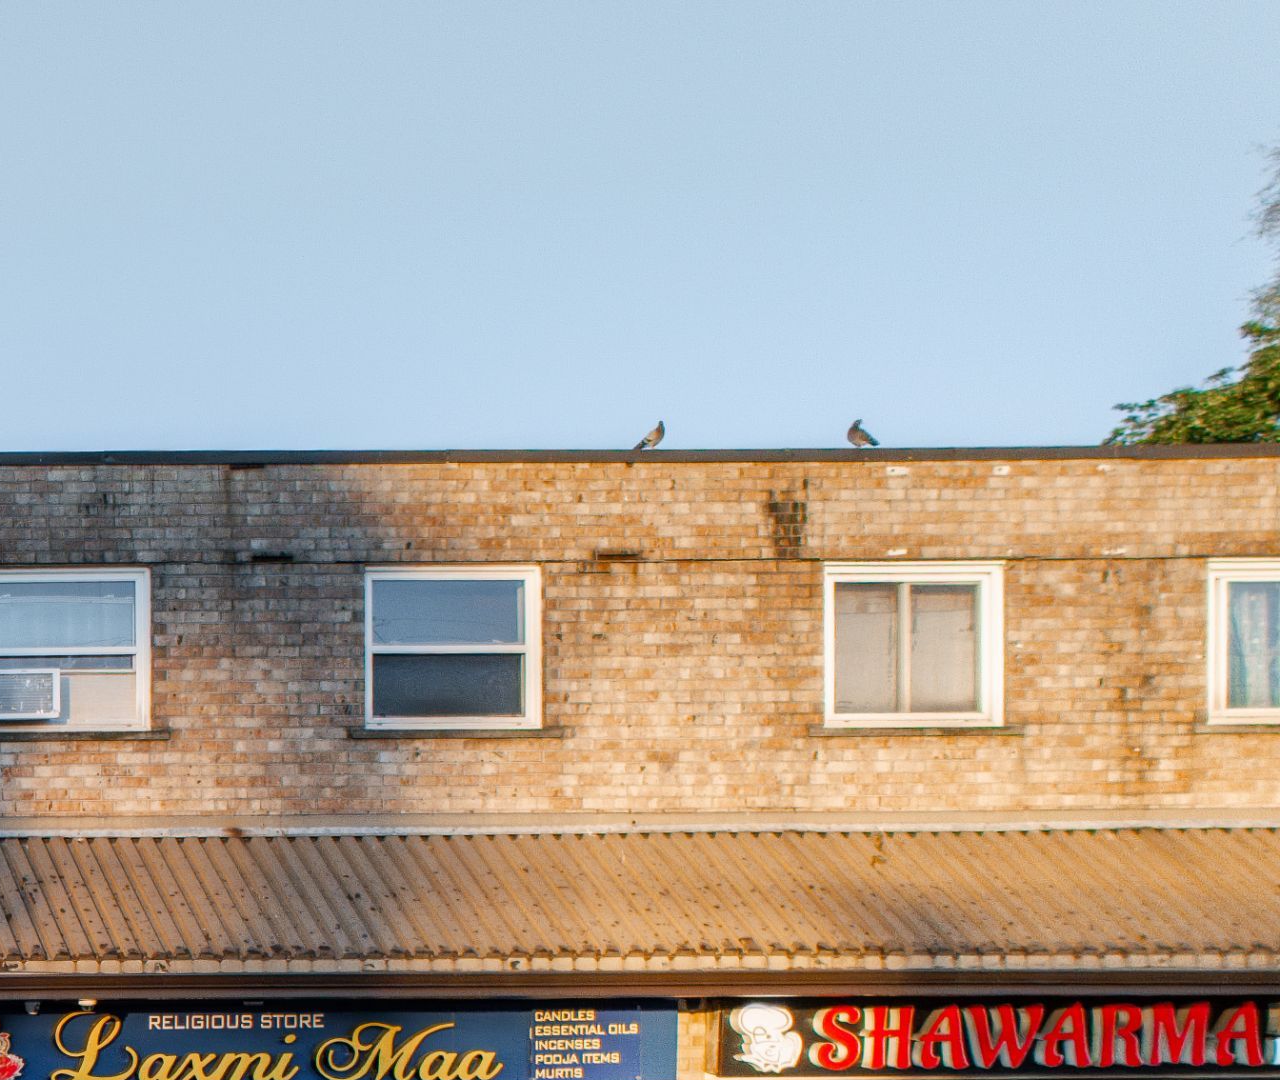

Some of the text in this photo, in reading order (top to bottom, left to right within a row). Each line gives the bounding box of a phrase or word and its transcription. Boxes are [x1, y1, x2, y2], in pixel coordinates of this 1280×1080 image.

[534, 1010, 595, 1021] CANDLES
[148, 1014, 325, 1030] RELIGIOUS STORE
[534, 1023, 639, 1036] ESSENTIAL OILS
[811, 1001, 1264, 1070] SHAWARMA
[534, 1038, 601, 1050] INCENSES
[582, 1052, 621, 1064] ITEMS
[535, 1067, 584, 1079] MURTIS
